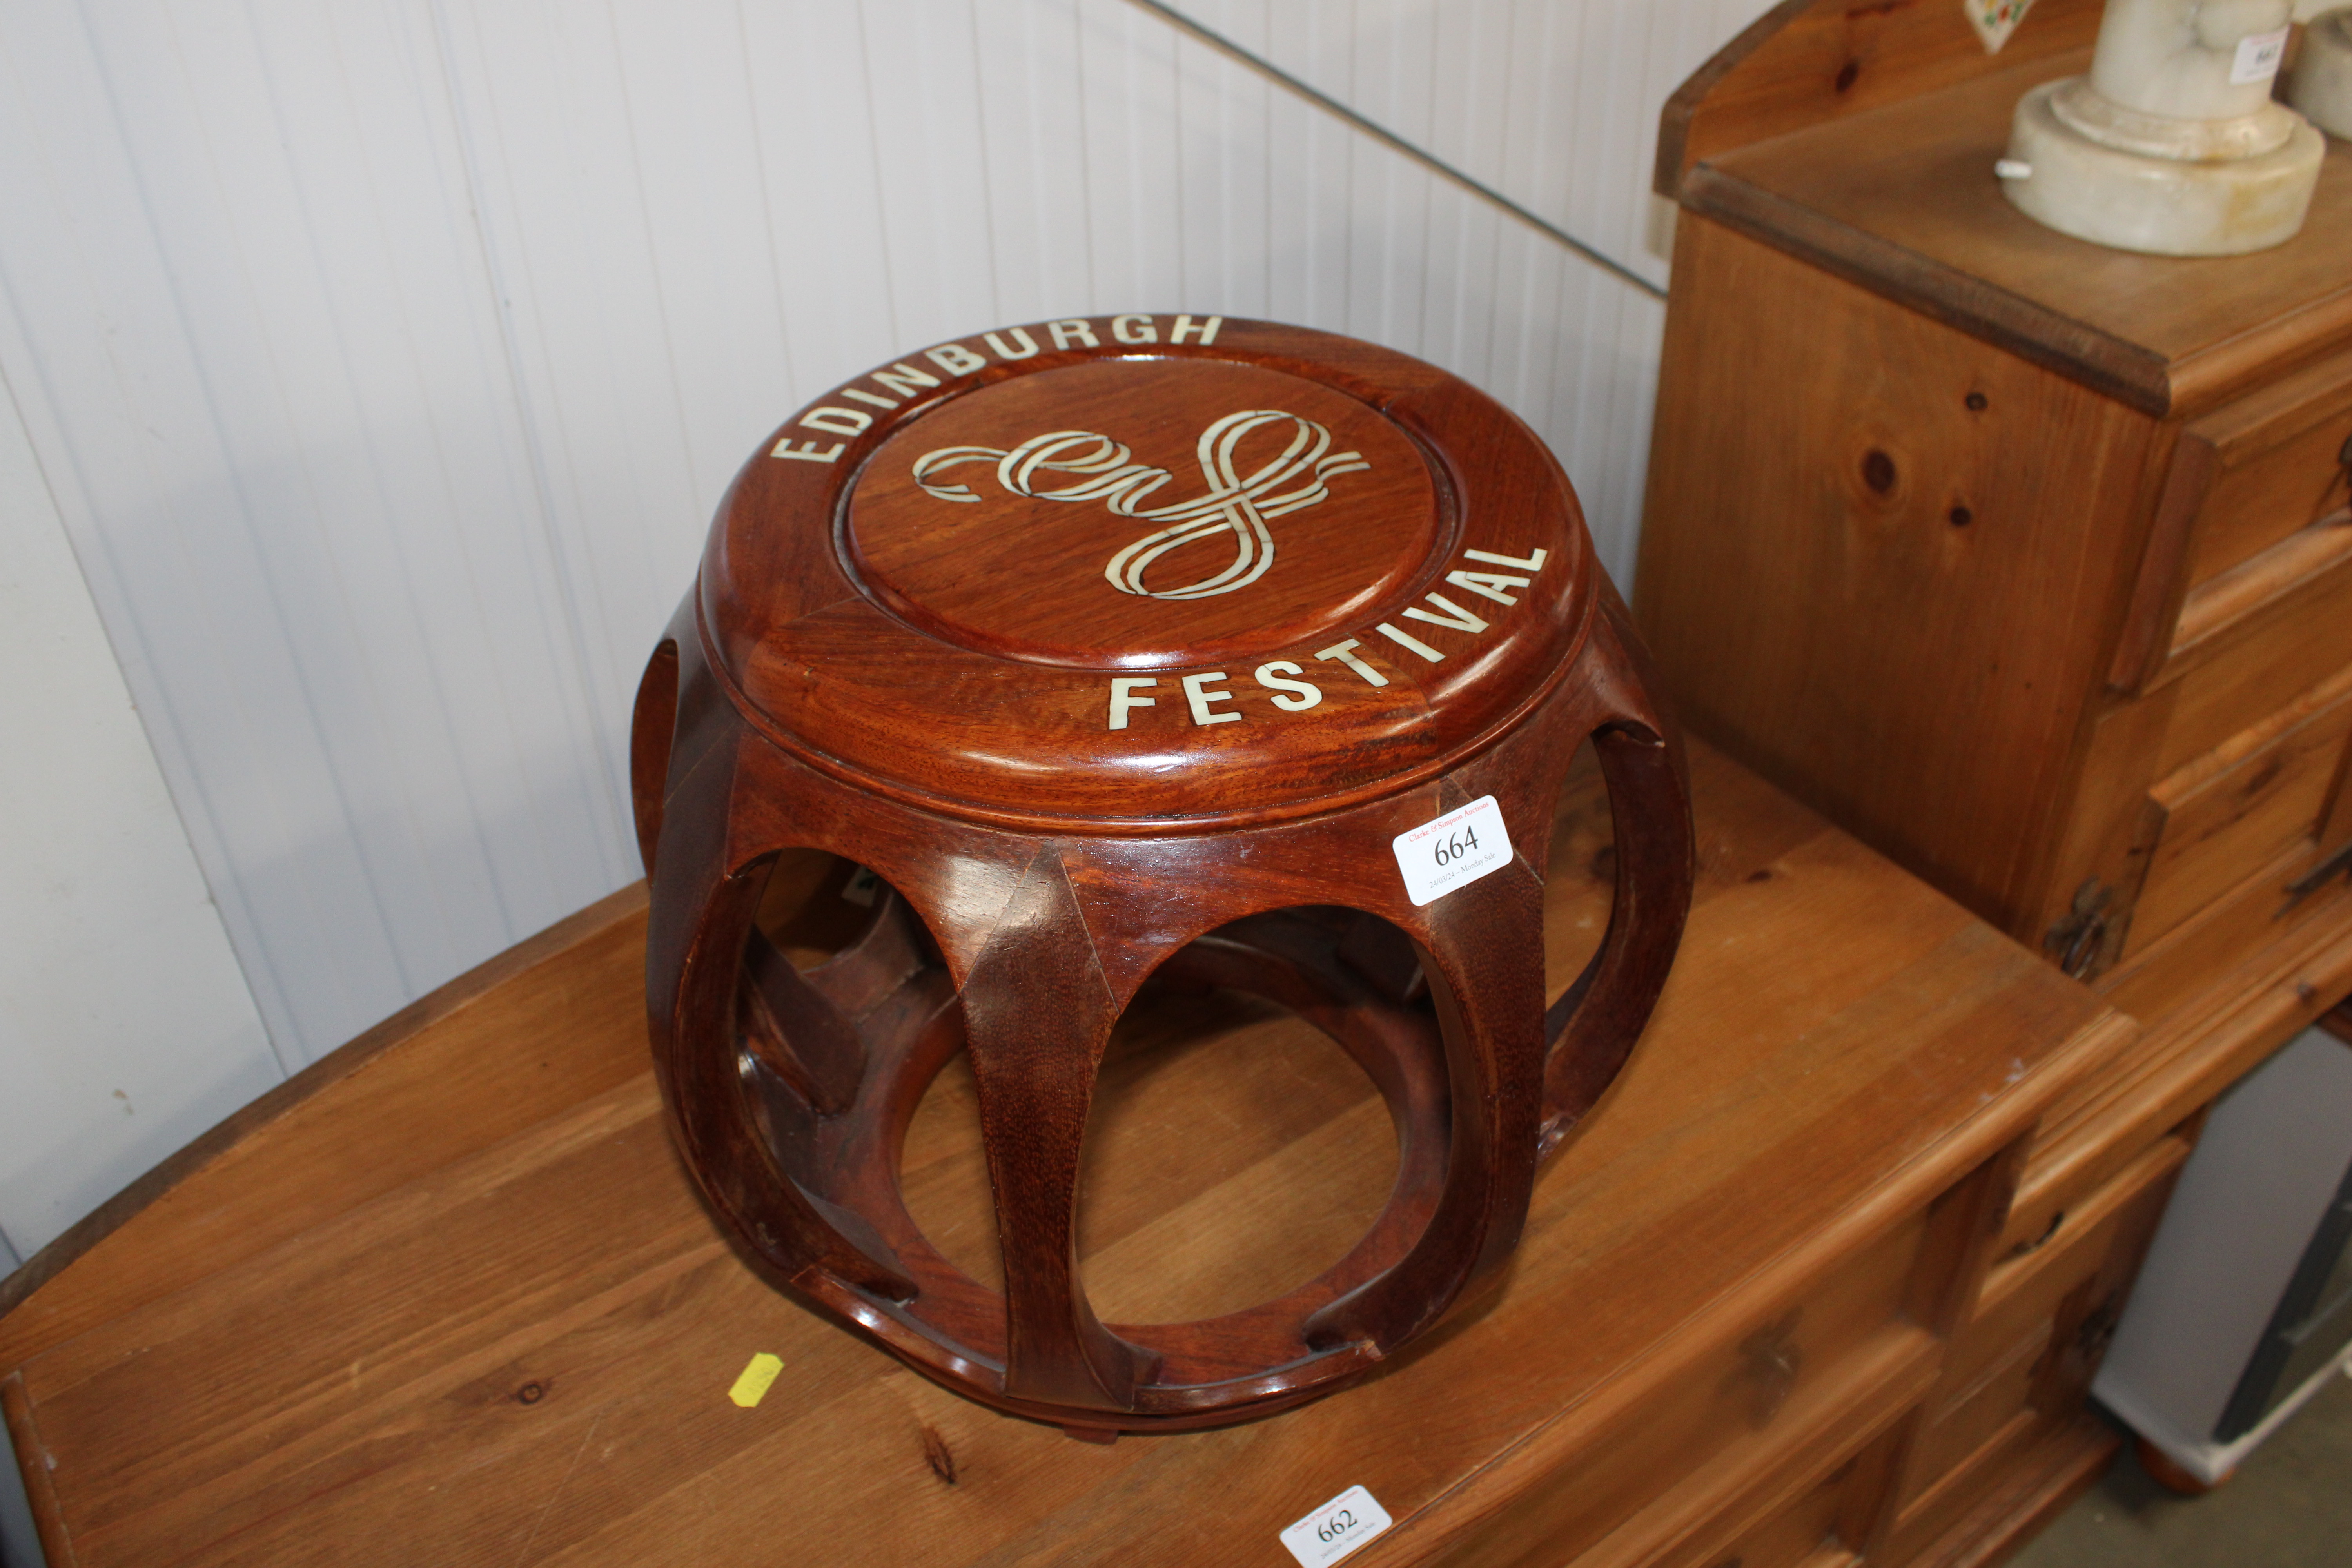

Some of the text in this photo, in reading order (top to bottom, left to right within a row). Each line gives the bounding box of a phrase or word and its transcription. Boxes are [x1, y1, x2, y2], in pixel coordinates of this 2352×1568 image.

[770, 314, 1223, 463] EDINBURGH
[1109, 548, 1548, 730] FESTIVAL
[1408, 829, 1430, 842] Clarke
[1438, 813, 1463, 830] Simpson
[1464, 802, 1489, 817] Auctions
[1435, 825, 1479, 866] 664
[1429, 871, 1455, 888] 24/03/24
[1461, 859, 1484, 874] Monday
[1484, 852, 1496, 863] Sale
[1318, 1510, 1358, 1542] 662
